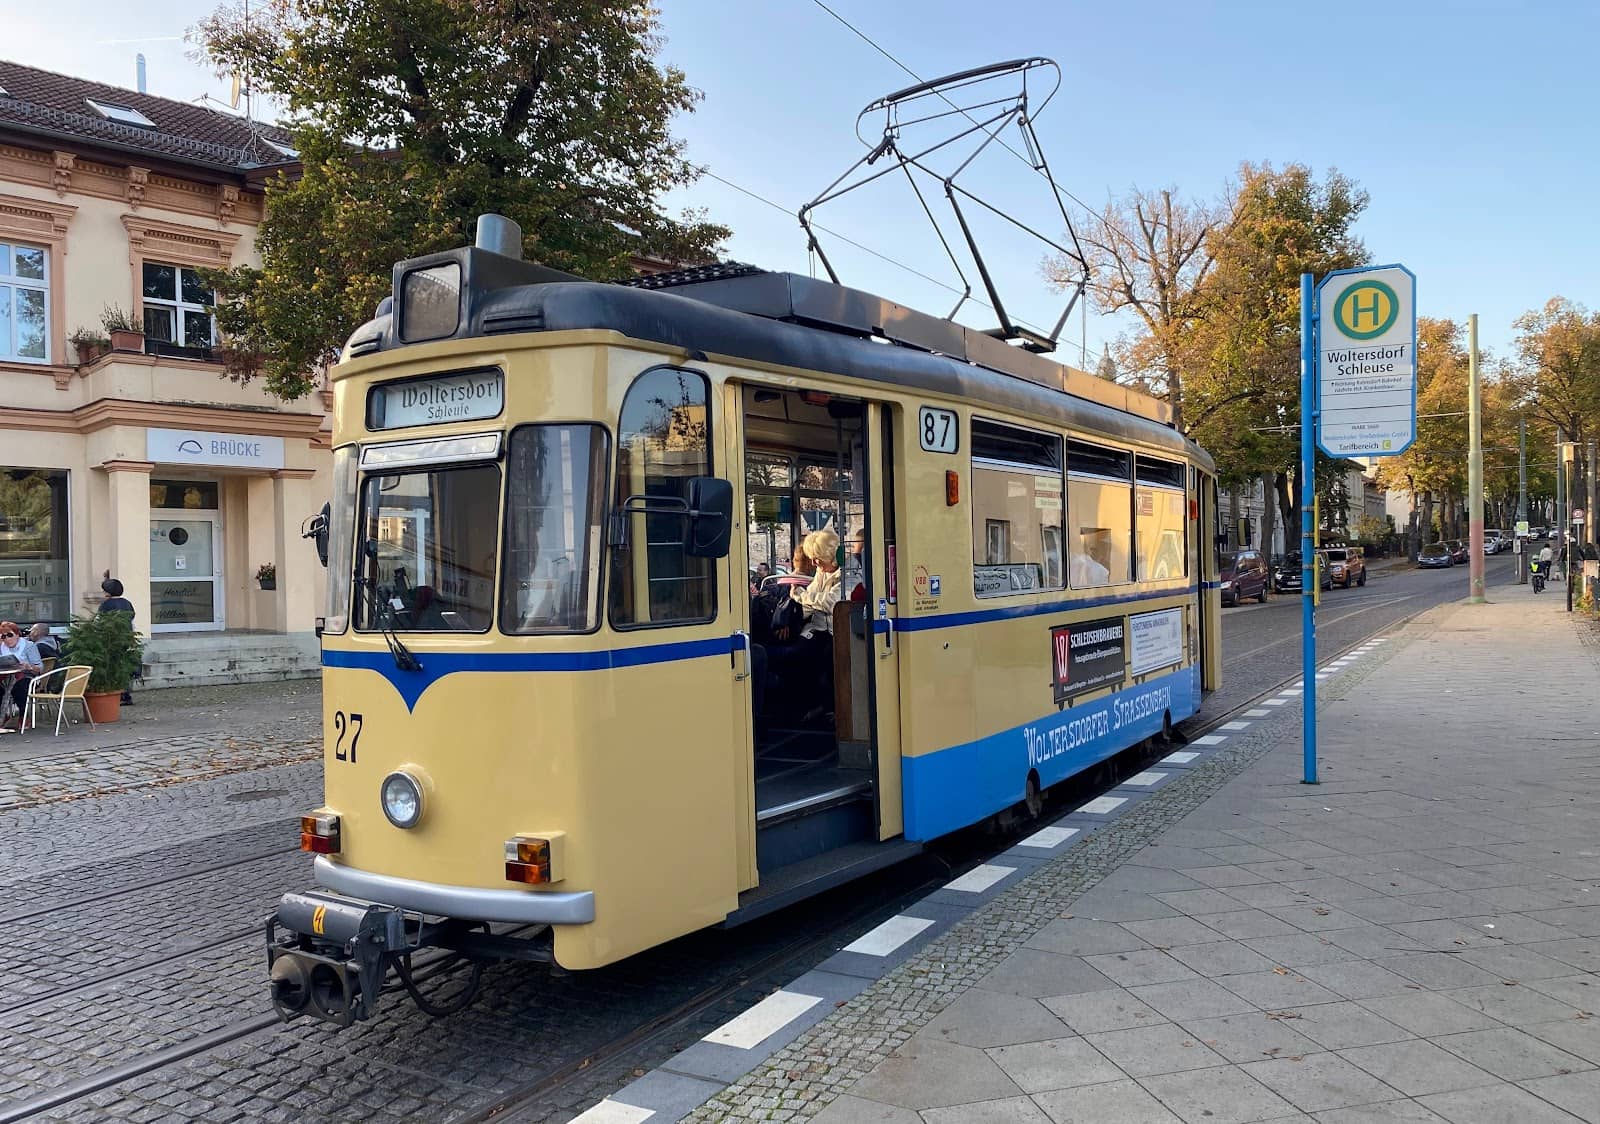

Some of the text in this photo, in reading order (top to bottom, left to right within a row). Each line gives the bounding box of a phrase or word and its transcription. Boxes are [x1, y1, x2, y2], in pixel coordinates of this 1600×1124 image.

[1352, 293, 1379, 328] H
[1327, 346, 1405, 363] Woltersdorf
[1337, 363, 1394, 376] Schleuse
[924, 412, 951, 447] 87
[211, 439, 261, 457] BRÜCKE
[1339, 442, 1379, 450] Tarifbereich
[1070, 625, 1123, 648] SCHLEUSENBRAUEREI
[334, 710, 363, 764] 27
[1024, 685, 1171, 767] WOLTERSDORFER STRASSENBAHN
